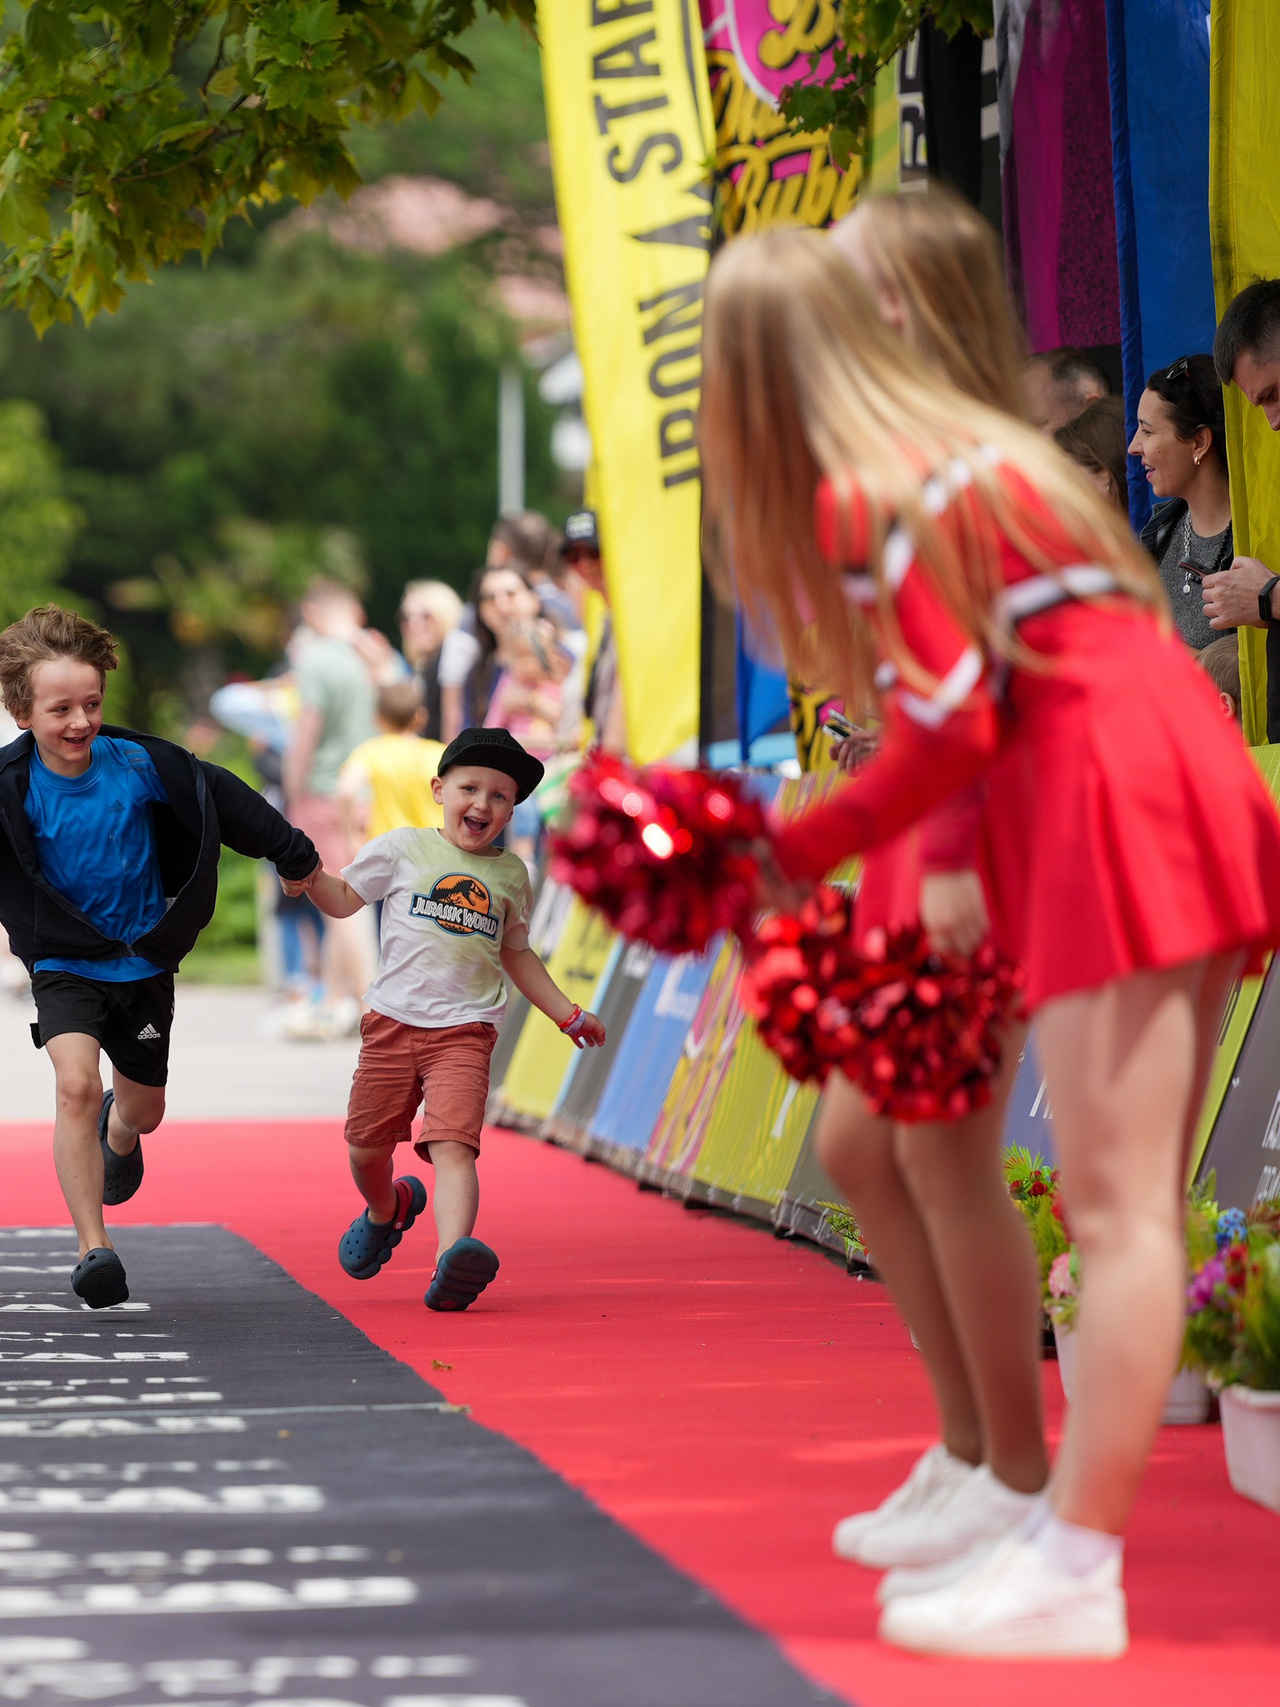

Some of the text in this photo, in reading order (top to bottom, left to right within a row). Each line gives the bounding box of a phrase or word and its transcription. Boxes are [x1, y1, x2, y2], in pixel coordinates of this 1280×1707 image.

[412, 897, 498, 935] JURASSIC WORLD
[137, 1032, 161, 1040] adidas
